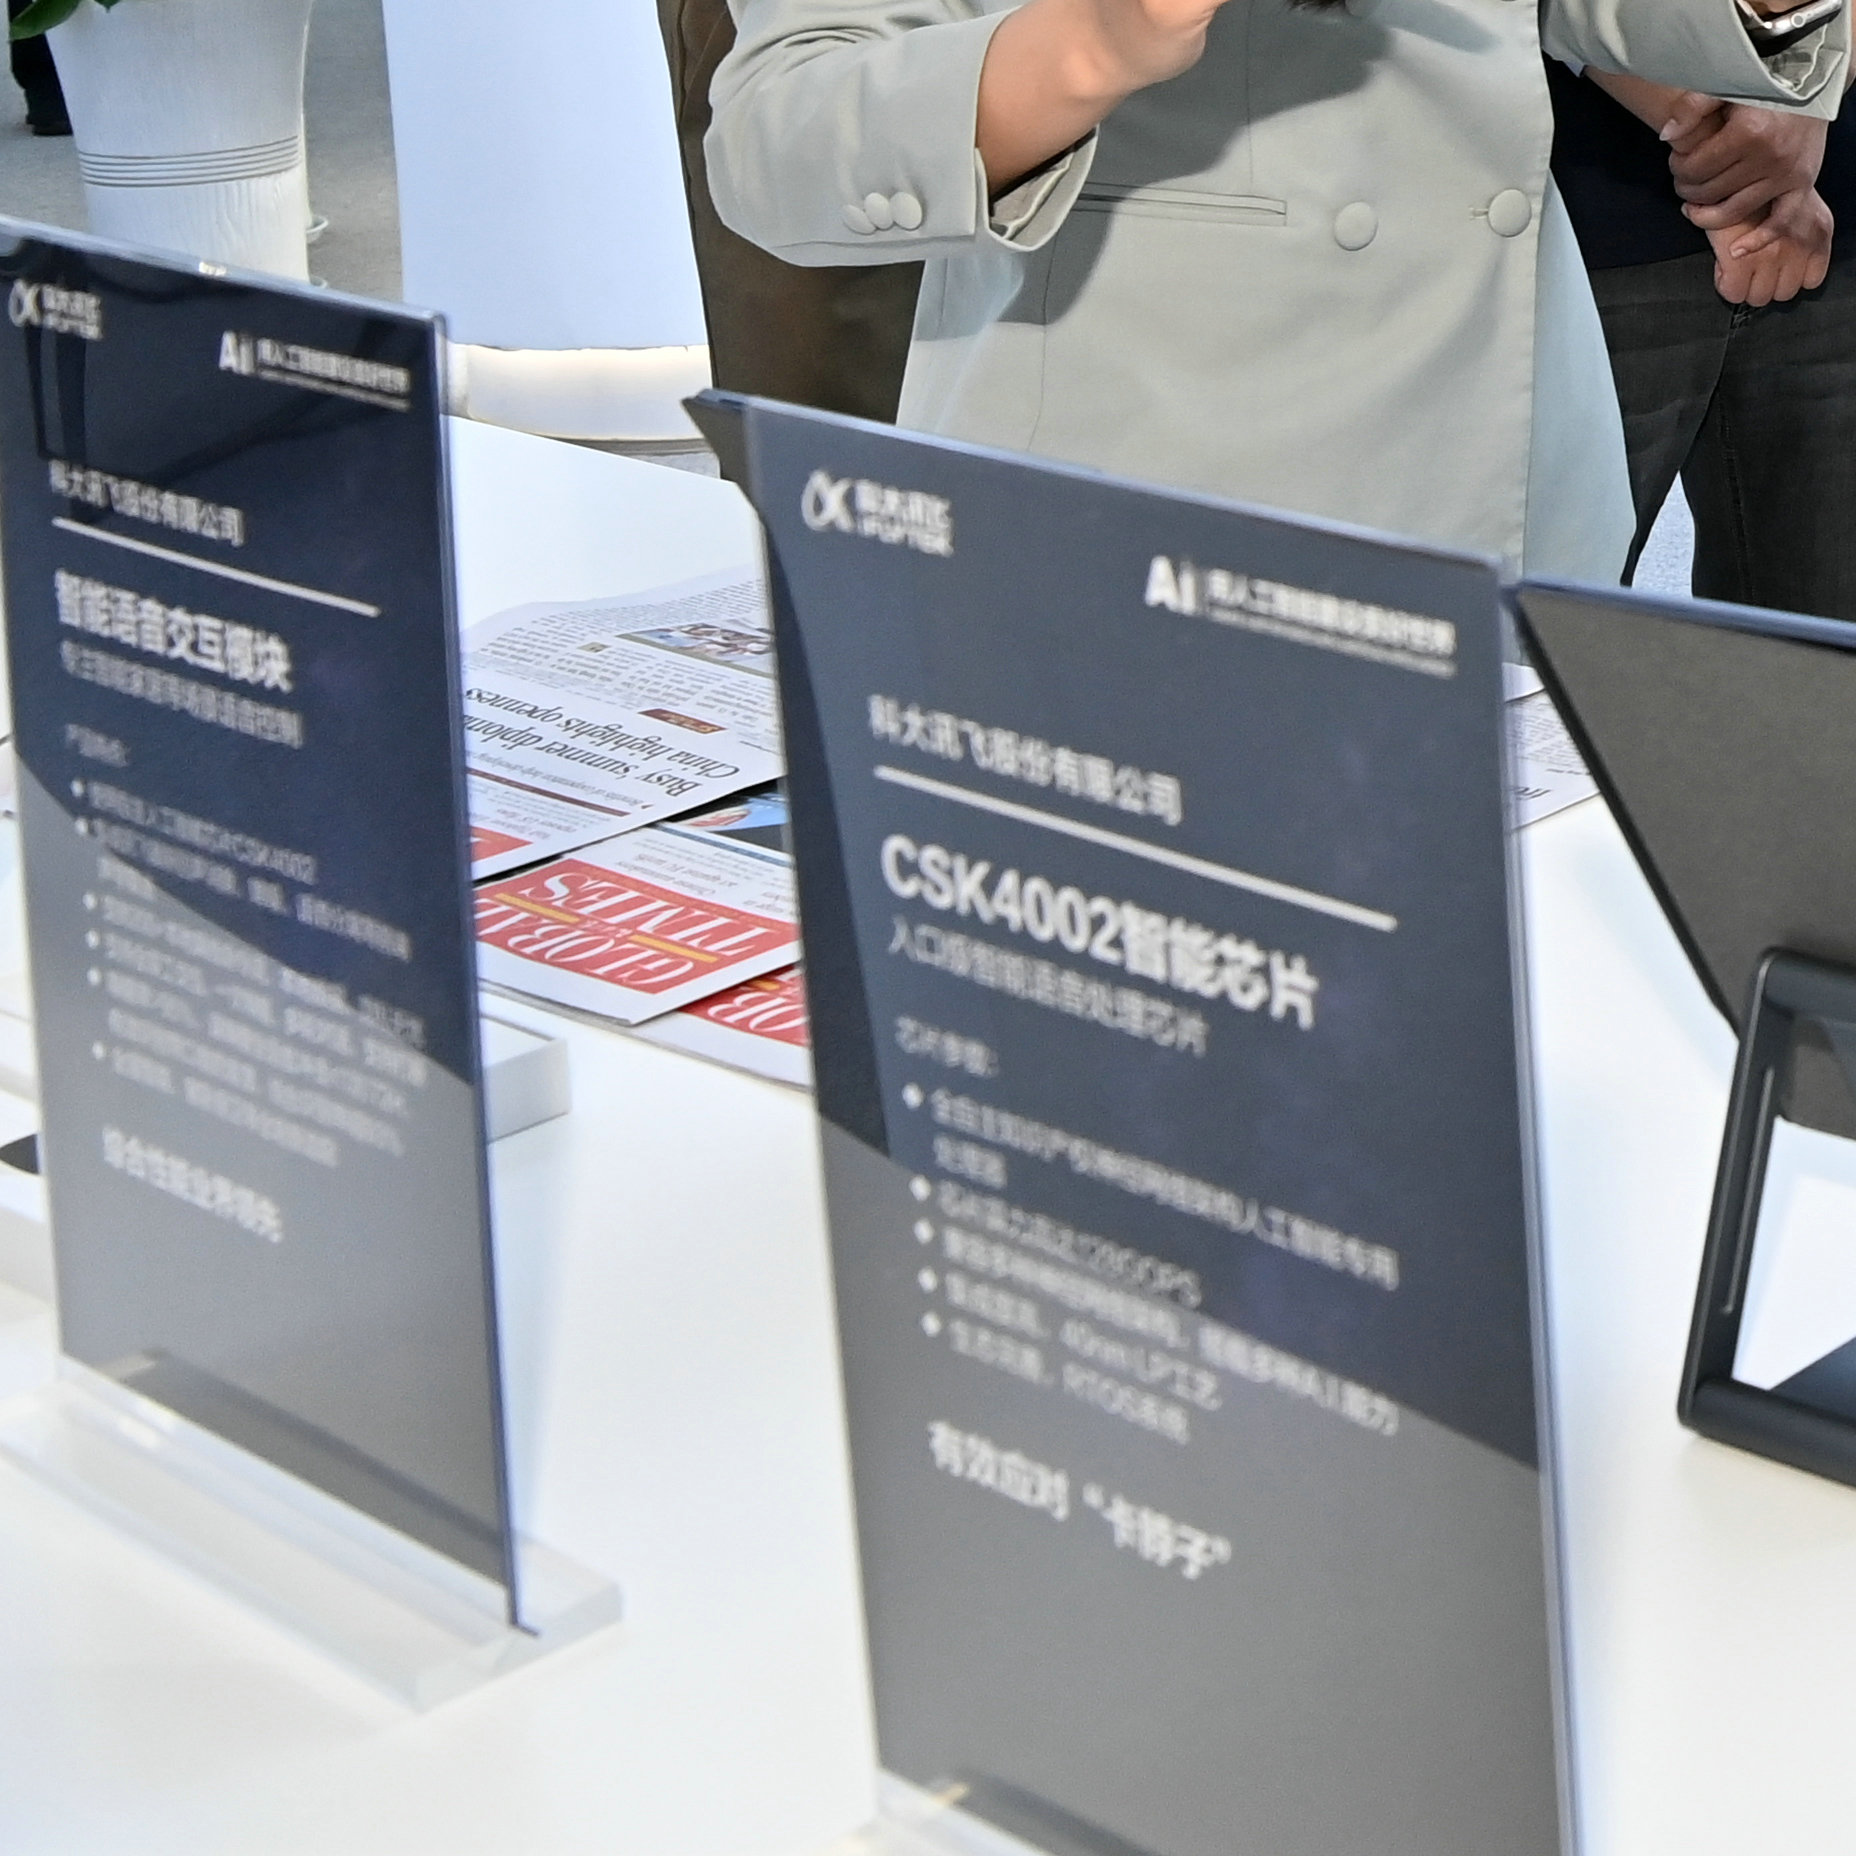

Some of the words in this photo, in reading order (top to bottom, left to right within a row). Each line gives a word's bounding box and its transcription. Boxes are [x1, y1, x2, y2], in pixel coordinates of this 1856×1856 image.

[54, 570, 292, 692] 智能语音交互模块
[465, 687, 564, 723] openness
[462, 714, 544, 750] diplom
[556, 718, 674, 762] highlights
[637, 768, 703, 797] Busy
[667, 750, 740, 779] China
[869, 695, 1182, 826] 科大讯飞股份有限公司
[517, 873, 781, 956] TIMES
[881, 834, 1319, 1029] CSK4002智能芯片
